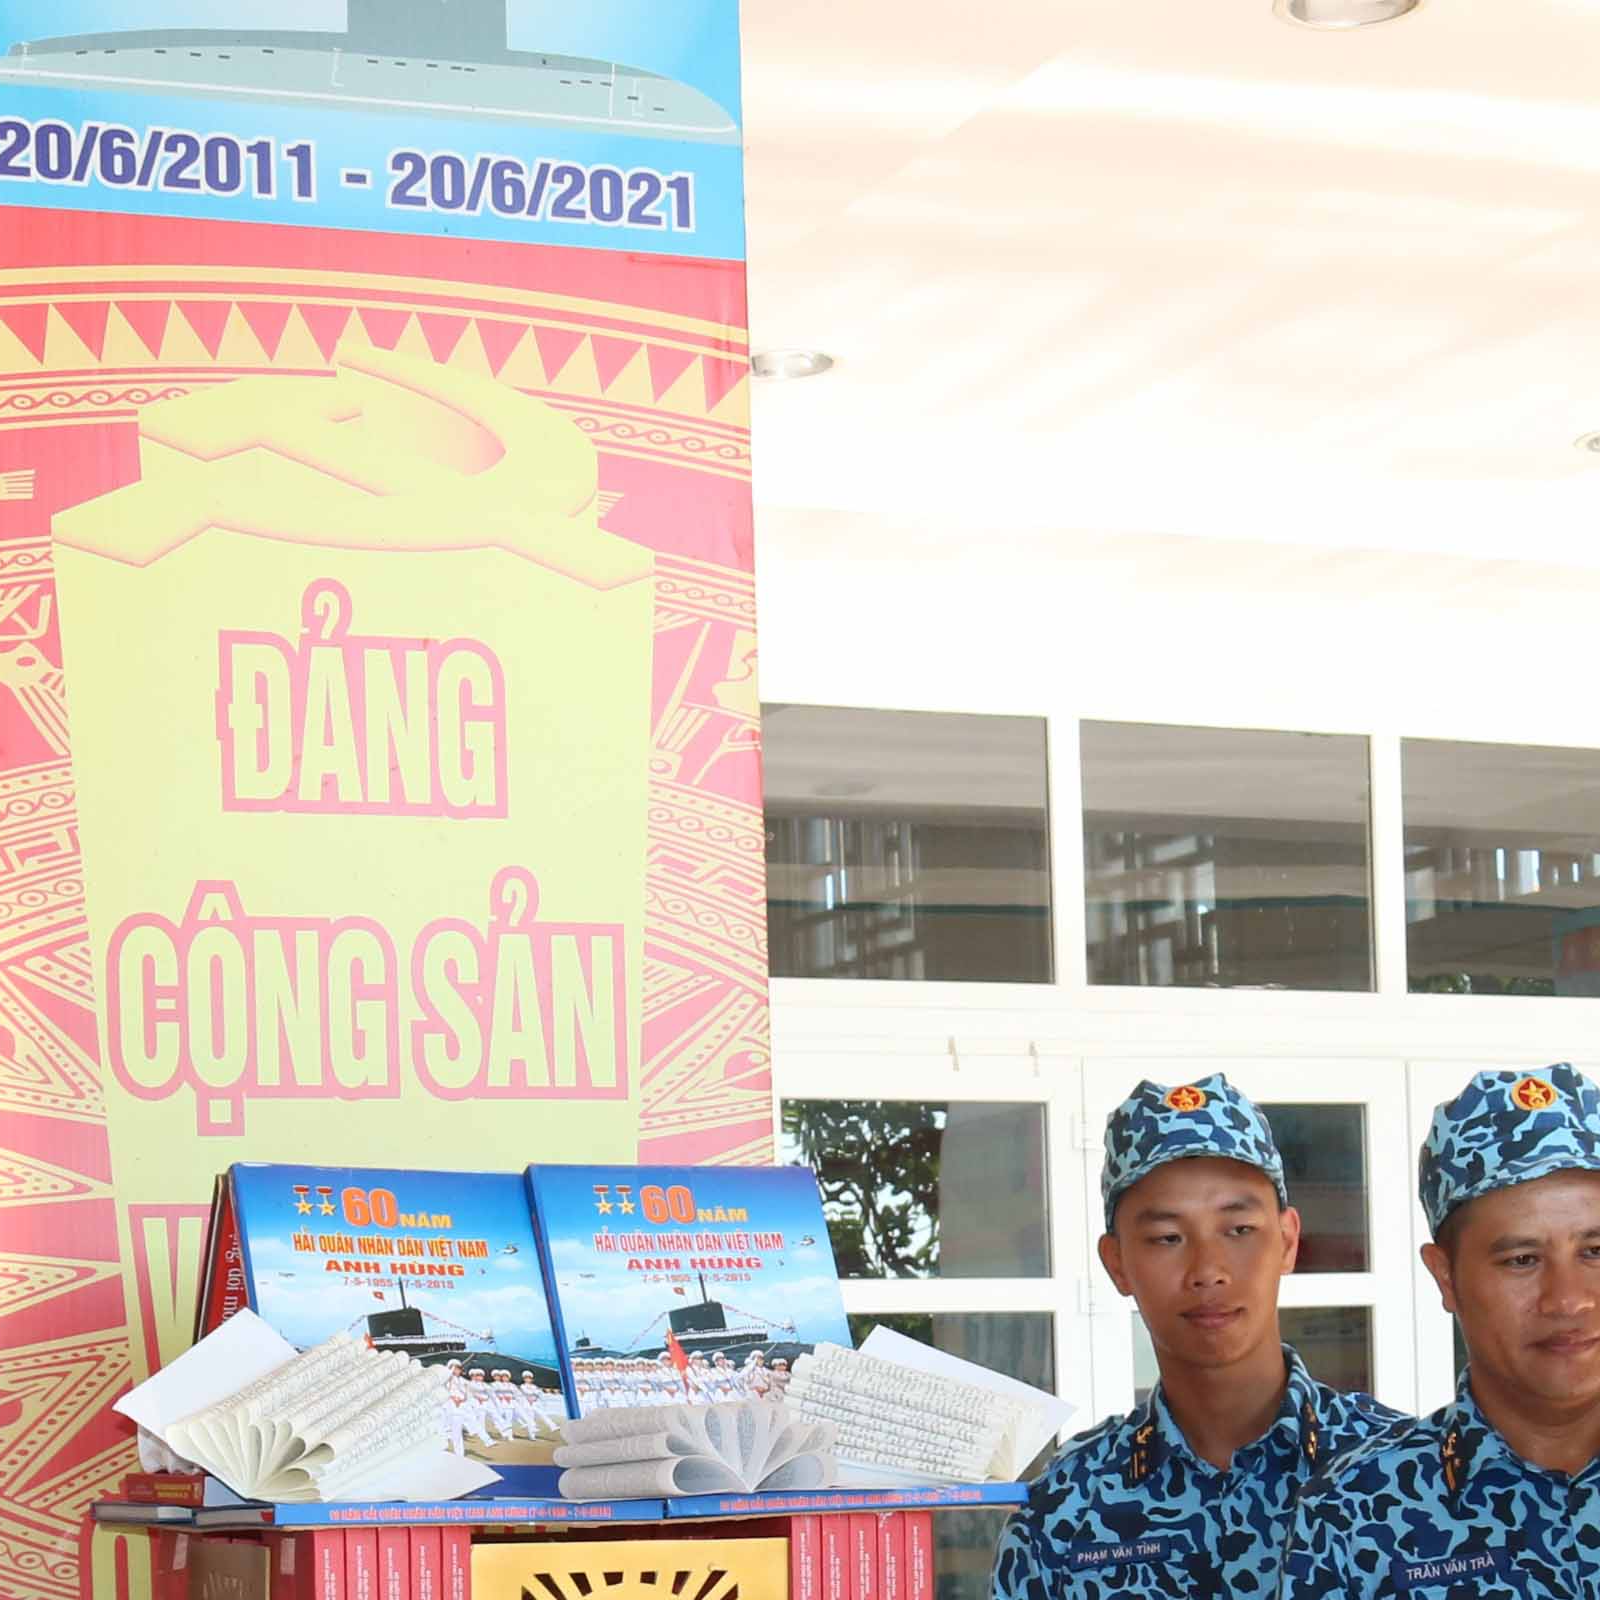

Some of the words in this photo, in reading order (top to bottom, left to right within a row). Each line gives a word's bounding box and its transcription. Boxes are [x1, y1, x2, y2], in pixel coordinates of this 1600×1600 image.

[344, 168, 369, 186] -
[389, 150, 696, 230] 20/6/2021
[218, 580, 506, 816] ĐẢNG
[107, 880, 399, 1136] CỘNG
[409, 866, 628, 1100] SẢN
[342, 1186, 398, 1229] 60
[400, 1211, 452, 1228] NĂM
[639, 1185, 696, 1224] 60
[697, 1206, 748, 1223] NĂM
[293, 1227, 315, 1252] HẢI
[319, 1233, 354, 1255] QUÂN
[358, 1235, 393, 1256] NHÂN
[397, 1234, 423, 1257] DÂN
[427, 1236, 454, 1262] VIỆT
[457, 1240, 488, 1258] NAM
[594, 1225, 616, 1252] HẢI
[619, 1230, 654, 1252] QUÂN
[658, 1230, 694, 1252] NHÂN
[696, 1230, 722, 1251] DÂN
[726, 1229, 752, 1256] VIỆT
[754, 1232, 784, 1250] NAM
[325, 1260, 381, 1274] ANH
[390, 1258, 464, 1276] HÙNG
[627, 1257, 681, 1271] ANH
[690, 1254, 762, 1270] HÙNG
[1076, 1549, 1108, 1566] PHẠM
